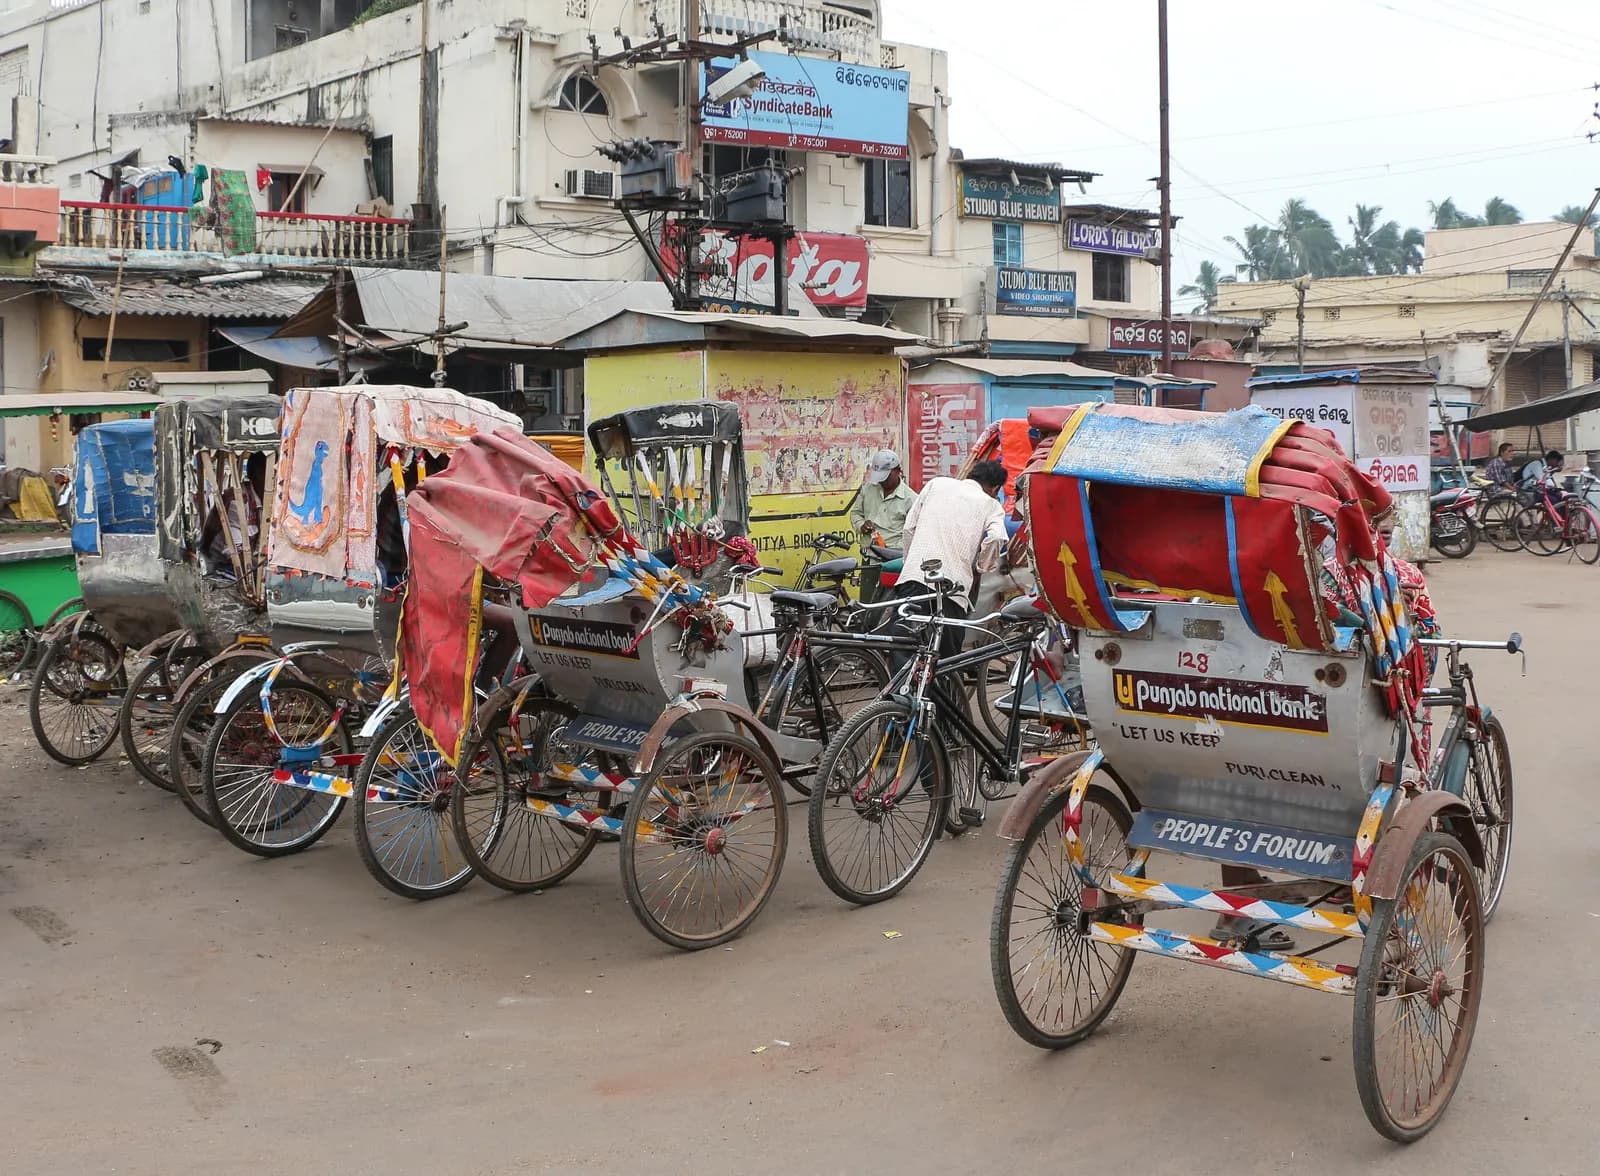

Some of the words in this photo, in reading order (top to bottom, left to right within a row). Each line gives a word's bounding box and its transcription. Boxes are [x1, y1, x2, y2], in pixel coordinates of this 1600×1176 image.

[744, 97, 833, 119] SyndicateBank
[862, 144, 875, 153] Puri
[880, 145, 902, 156] 752001
[964, 197, 998, 216] STUDIO
[1000, 200, 1023, 218] BLUE
[1025, 203, 1059, 221] HEAVEN
[1072, 222, 1109, 246] LORDS
[1111, 228, 1152, 250] TAILORS
[682, 229, 862, 298] Bata
[1000, 271, 1027, 290] STUDIO
[1028, 273, 1046, 290] BLUE
[1048, 274, 1074, 293] HEAVEN
[1010, 292, 1031, 301] VIDEO
[1032, 293, 1064, 303] SHOOTING
[751, 535, 786, 552] DITYA
[793, 532, 822, 549] BIRL
[575, 627, 611, 648] national
[611, 630, 634, 649] bank
[556, 654, 569, 666] US
[1177, 651, 1209, 673] 128
[1200, 687, 1268, 715] national
[1269, 689, 1320, 721] bank
[577, 721, 638, 744] PEOPLE'S
[634, 731, 680, 749] FOM
[1153, 728, 1175, 743] US
[1180, 731, 1221, 748] KEEP
[1158, 817, 1253, 852] PEOPLE'S
[1252, 833, 1336, 865] FORUM
